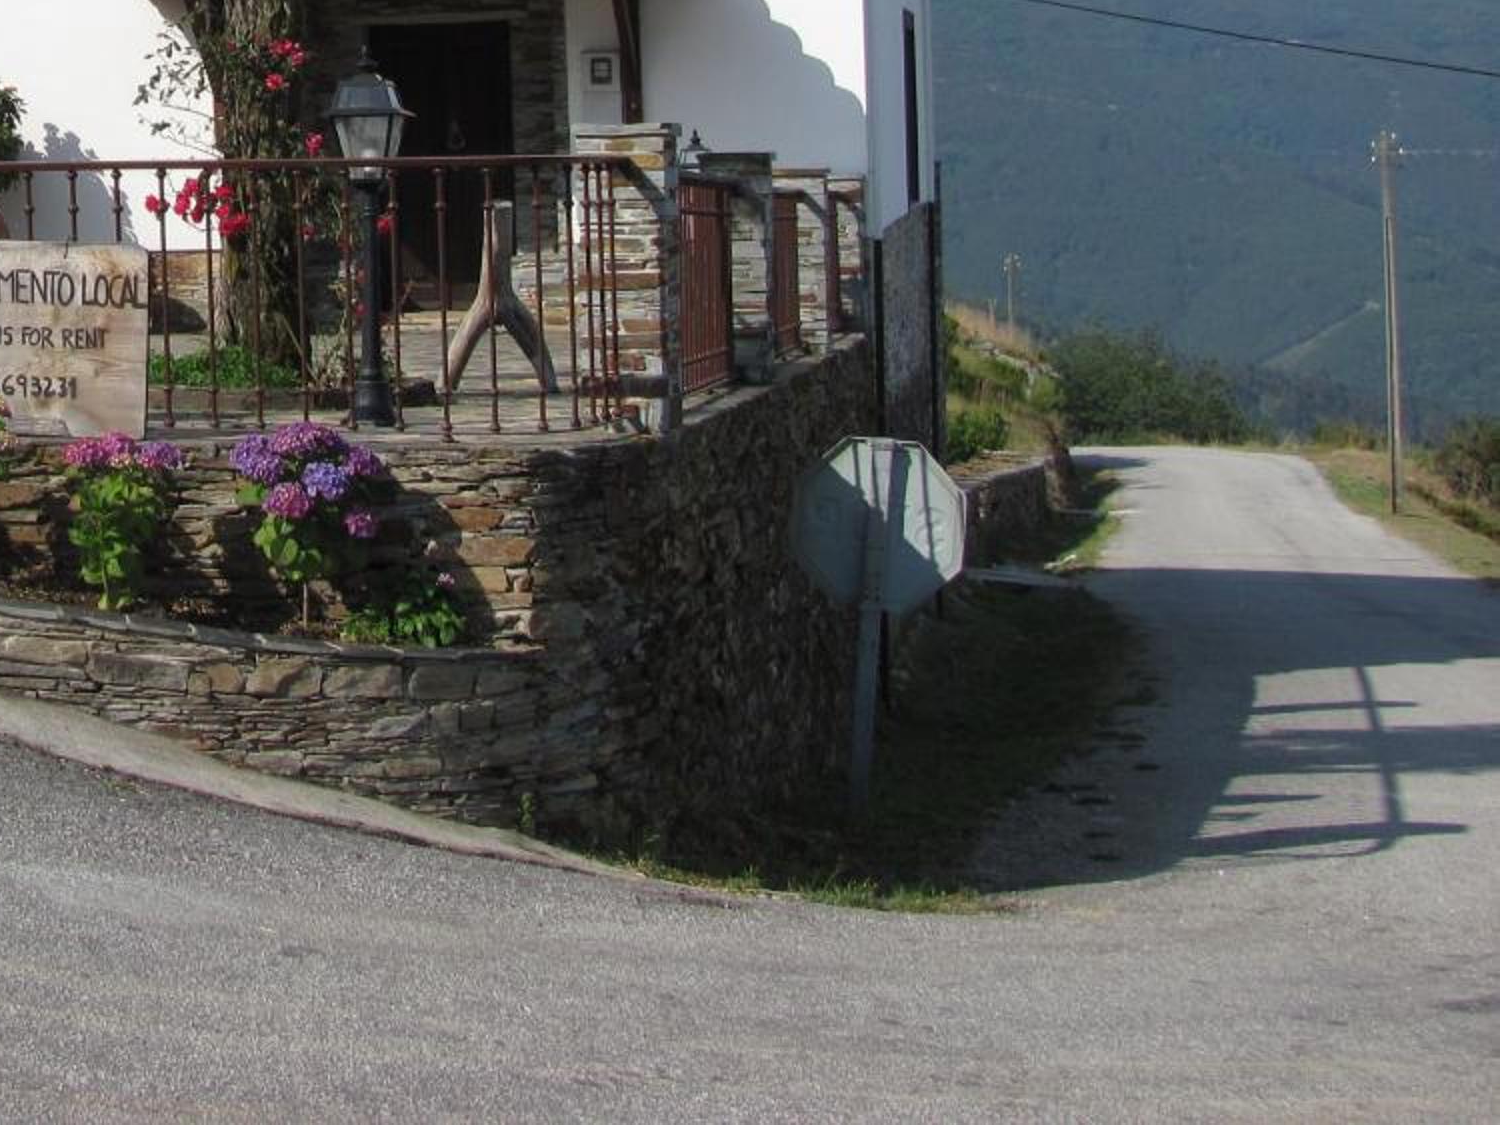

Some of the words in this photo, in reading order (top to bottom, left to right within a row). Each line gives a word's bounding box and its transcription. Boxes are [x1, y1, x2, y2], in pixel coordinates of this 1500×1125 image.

[82, 272, 148, 309] LOCAL
[21, 326, 55, 348] FOR
[62, 327, 109, 350] RENT
